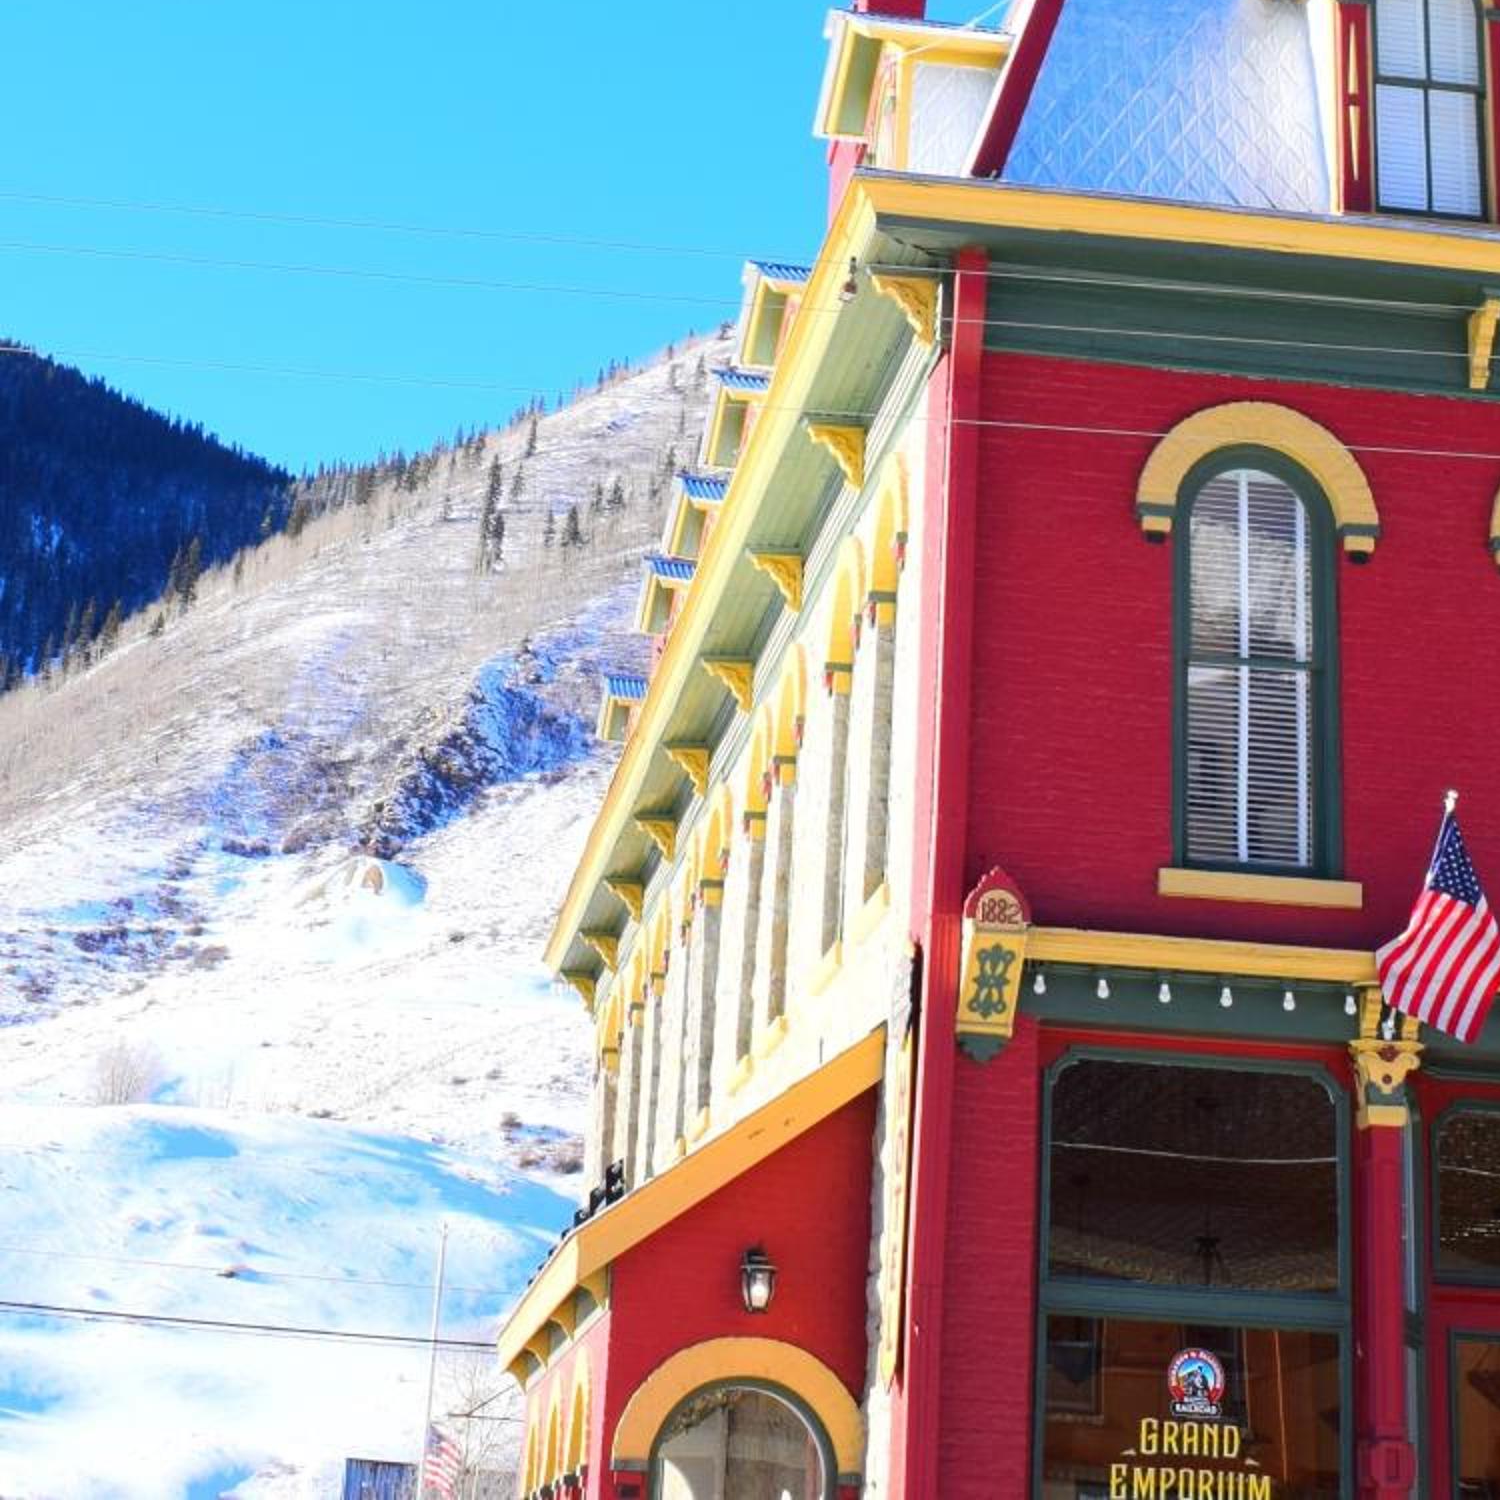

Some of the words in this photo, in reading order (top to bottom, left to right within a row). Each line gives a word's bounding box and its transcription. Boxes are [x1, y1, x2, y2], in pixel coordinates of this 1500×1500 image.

[980, 898, 1020, 924] 1882
[1140, 1417, 1241, 1459] GRAND
[1110, 1463, 1272, 1500] EMPORIUM
